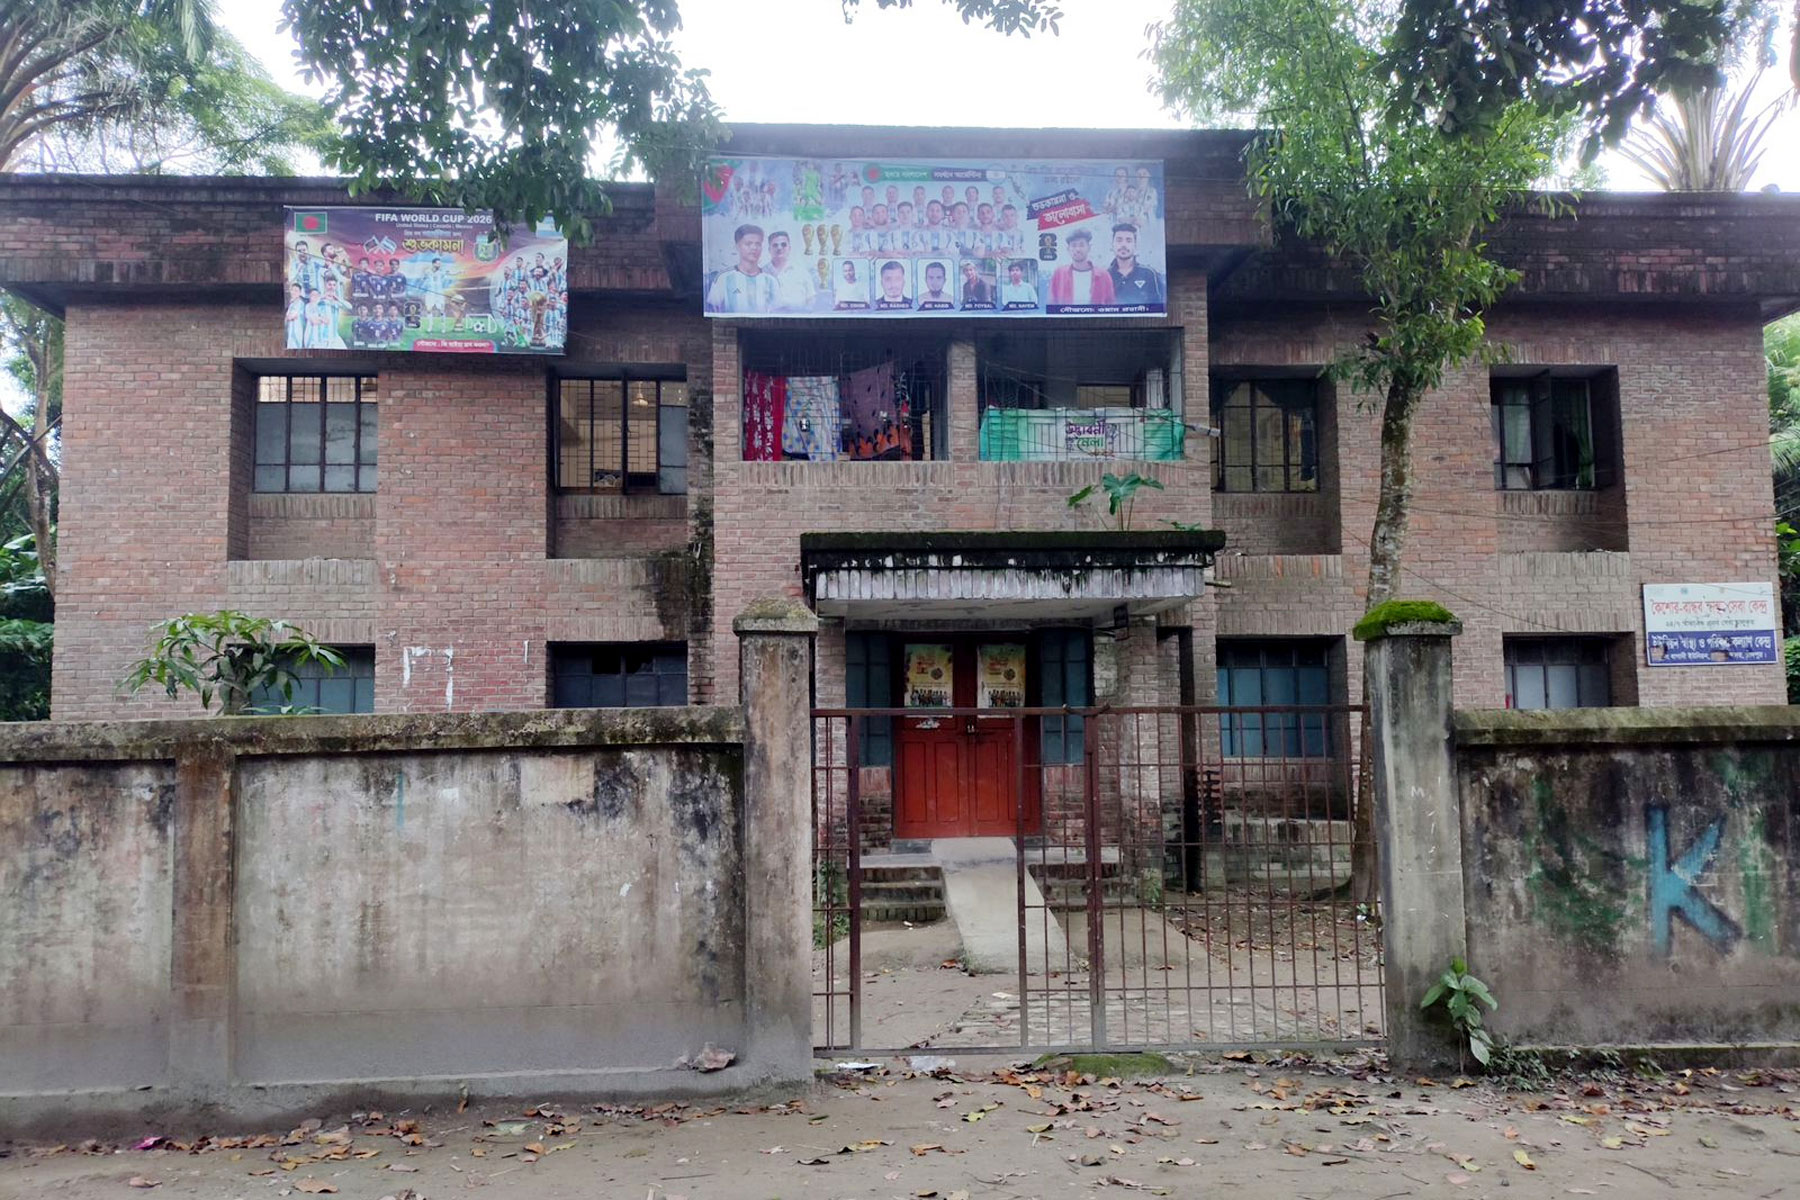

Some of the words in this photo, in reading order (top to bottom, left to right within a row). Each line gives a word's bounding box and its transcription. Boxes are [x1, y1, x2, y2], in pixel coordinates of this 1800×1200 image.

[375, 213, 398, 222] FIFA
[400, 213, 440, 223] WORLD
[442, 214, 464, 223] CUP
[467, 215, 493, 224] 2026
[402, 238, 465, 255] শুভকামনা
[1077, 437, 1104, 451] মেলা
[1728, 600, 1746, 614] সেবা
[1749, 600, 1769, 614] কেন্দ্র
[1699, 638, 1705, 648] ও
[1755, 636, 1771, 649] কেন্দ্র
